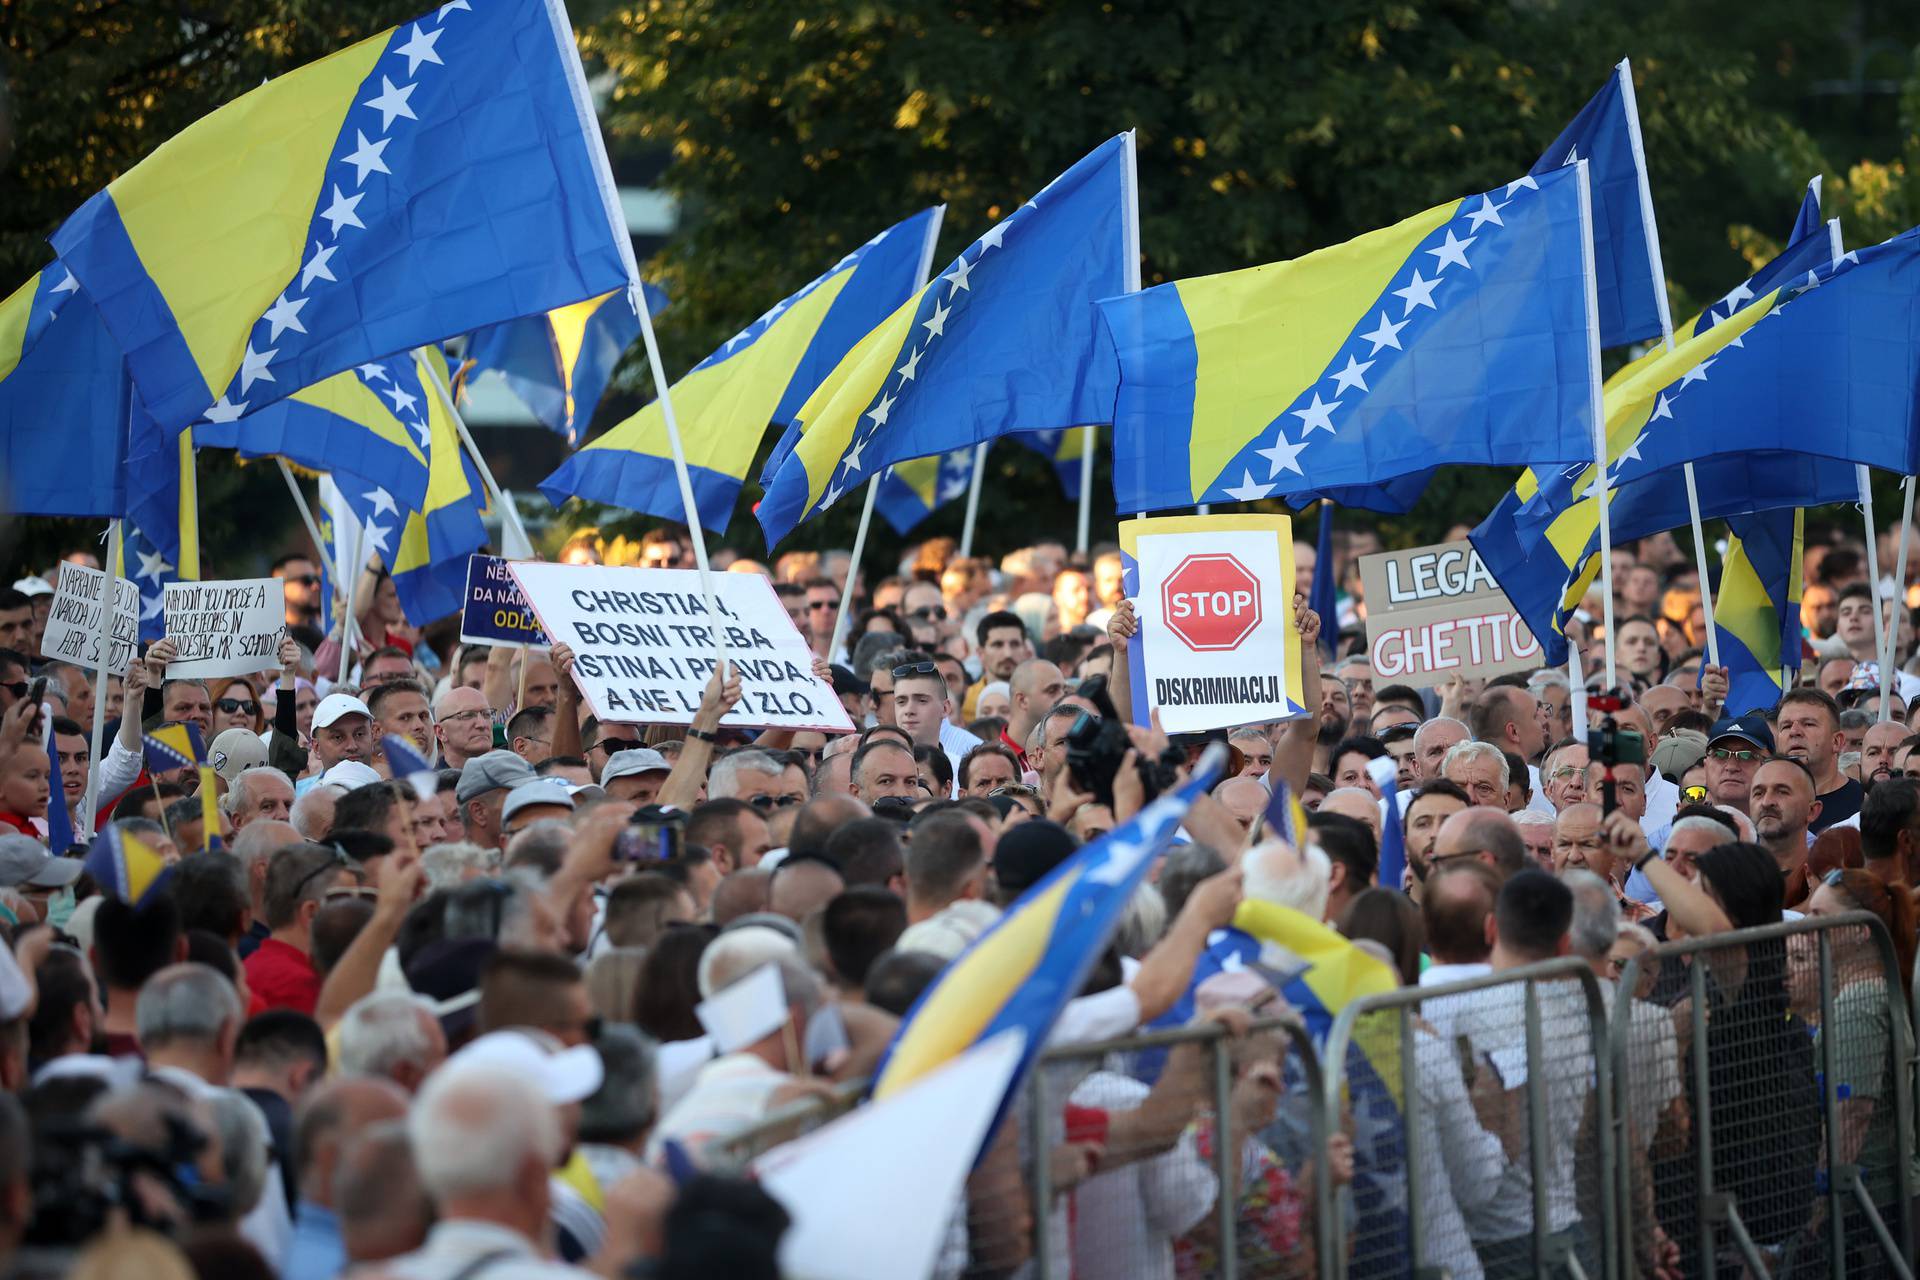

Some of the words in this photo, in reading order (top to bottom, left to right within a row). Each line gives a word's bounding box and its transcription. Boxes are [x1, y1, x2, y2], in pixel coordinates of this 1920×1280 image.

[1386, 548, 1501, 603] LEGA
[165, 588, 181, 612] WHY
[205, 588, 223, 611] YOU
[254, 585, 265, 608] A
[473, 587, 493, 603] DA
[1172, 590, 1252, 617] STOP
[51, 596, 88, 627] NARODA
[165, 613, 189, 634] HOUSE
[188, 613, 199, 633] OF
[230, 610, 244, 634] IN
[494, 610, 544, 632] ODLA
[57, 628, 87, 659] HERR
[216, 634, 233, 660] MR
[572, 621, 671, 647] BOSNI
[1372, 611, 1541, 678] GHETTO
[574, 654, 673, 680] ISTINA
[669, 657, 687, 680] I
[606, 687, 632, 712] A
[628, 688, 677, 713] NE
[752, 691, 824, 717] ZLO.
[1155, 675, 1280, 706] DISKRIMINACIJI
